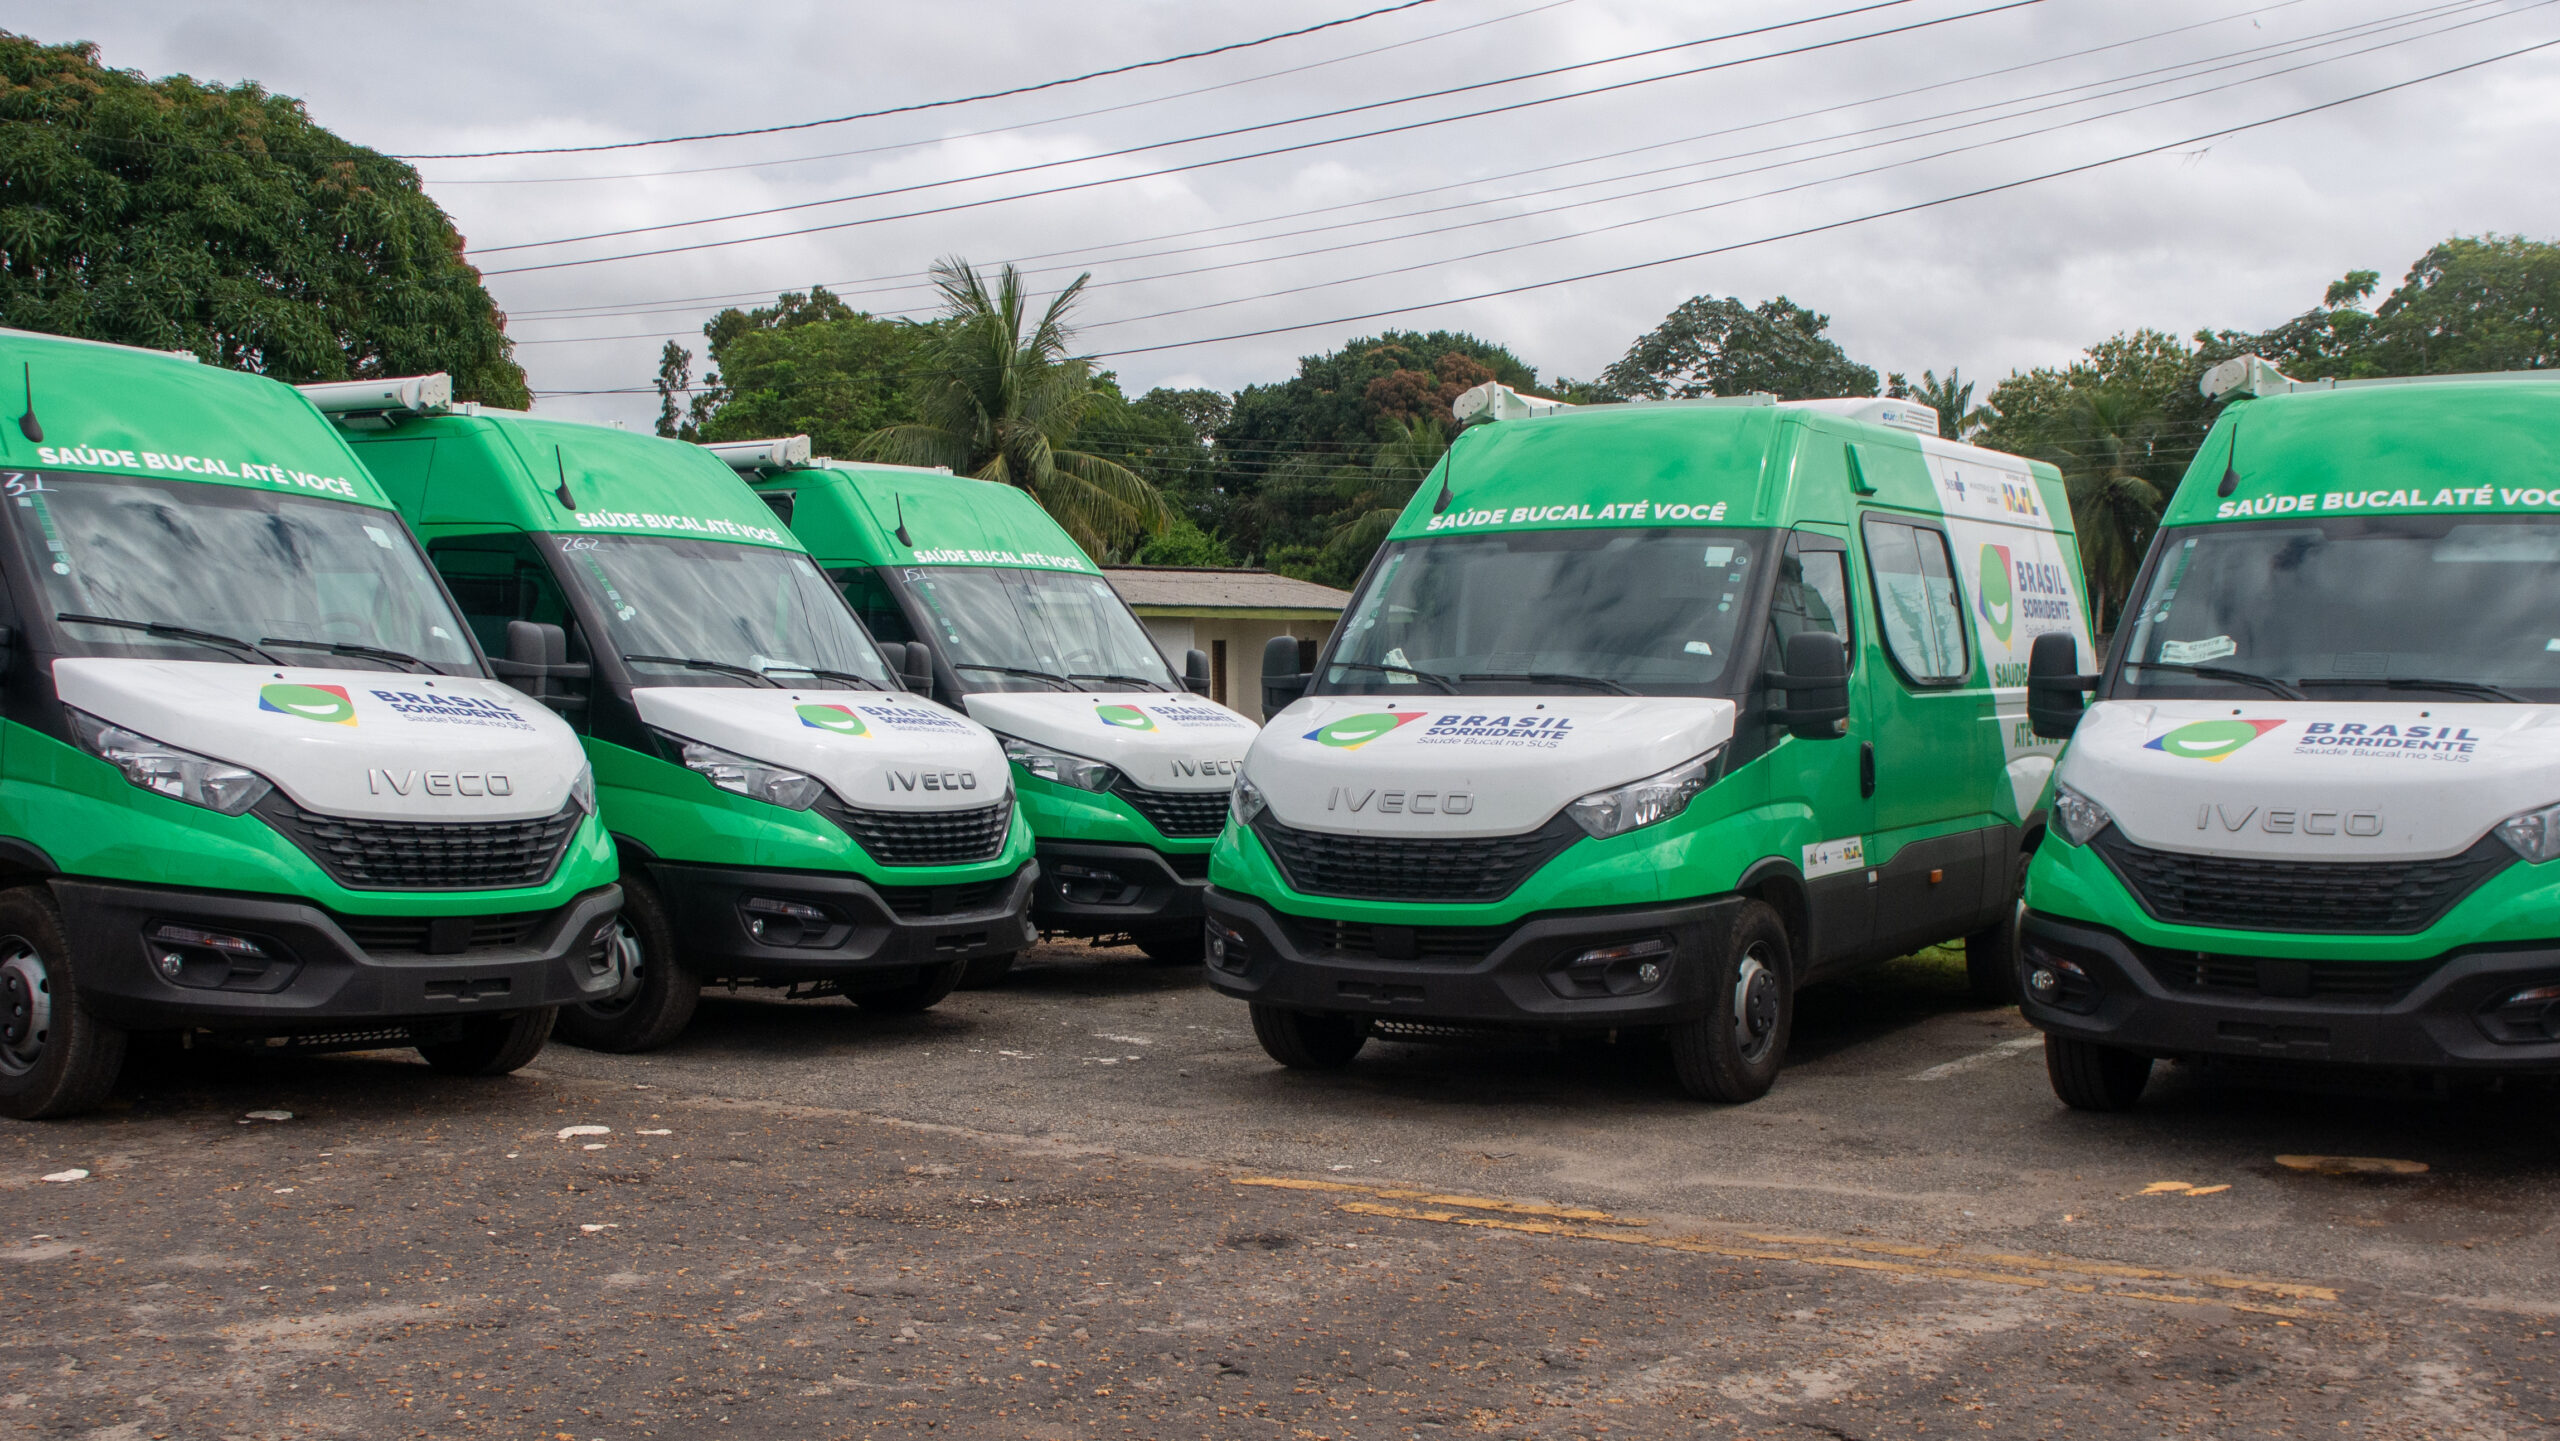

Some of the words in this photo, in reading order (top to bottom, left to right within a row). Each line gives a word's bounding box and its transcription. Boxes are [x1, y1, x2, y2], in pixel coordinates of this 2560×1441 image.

[38, 443, 140, 468] SAÚDE
[142, 452, 239, 478] BUCAL
[240, 462, 289, 485] ATÉ
[287, 470, 358, 498] VOCÊ
[2217, 493, 2316, 518] SAÚDE
[2322, 489, 2428, 510] BUCAL
[2432, 483, 2494, 506] ATÉ
[1426, 508, 1508, 531] SAÚDE
[1509, 504, 1594, 523] BUCAL
[1597, 500, 1649, 519] ATÉ
[1654, 501, 1728, 521] VOCÊ
[575, 509, 642, 528] SAÚDE
[643, 514, 709, 532] BUCAL
[706, 518, 740, 537] ATÉ
[736, 523, 785, 545] VOCÊ
[913, 546, 969, 564] SAÚDE
[968, 550, 1023, 565] BUCAL
[1021, 551, 1049, 567] ATÉ
[1045, 554, 1086, 571] VOCÊ
[2015, 560, 2067, 595] BRASIL
[2022, 598, 2071, 620] SORRIDENTE
[369, 690, 512, 711] BRASIL
[1149, 706, 1225, 716] BRASIL
[391, 703, 526, 722] SORRIDENTE
[858, 706, 952, 720] BRASIL
[1434, 715, 1574, 730] BRASIL
[508, 722, 537, 732] SUS
[1425, 727, 1569, 740] SORRIDENTE
[2305, 722, 2479, 742] BRASIL
[1464, 737, 1503, 746] Bucal
[1527, 740, 1559, 749] SUS
[2299, 735, 2476, 753] SORRIDENTE
[2352, 748, 2401, 759] Bucal
[2404, 751, 2427, 760] no
[2431, 752, 2471, 763] SUS
[369, 768, 514, 796] IVECO
[886, 770, 977, 792] IVECO
[1327, 786, 1475, 815] IVECO
[2197, 803, 2383, 837] IVECO
